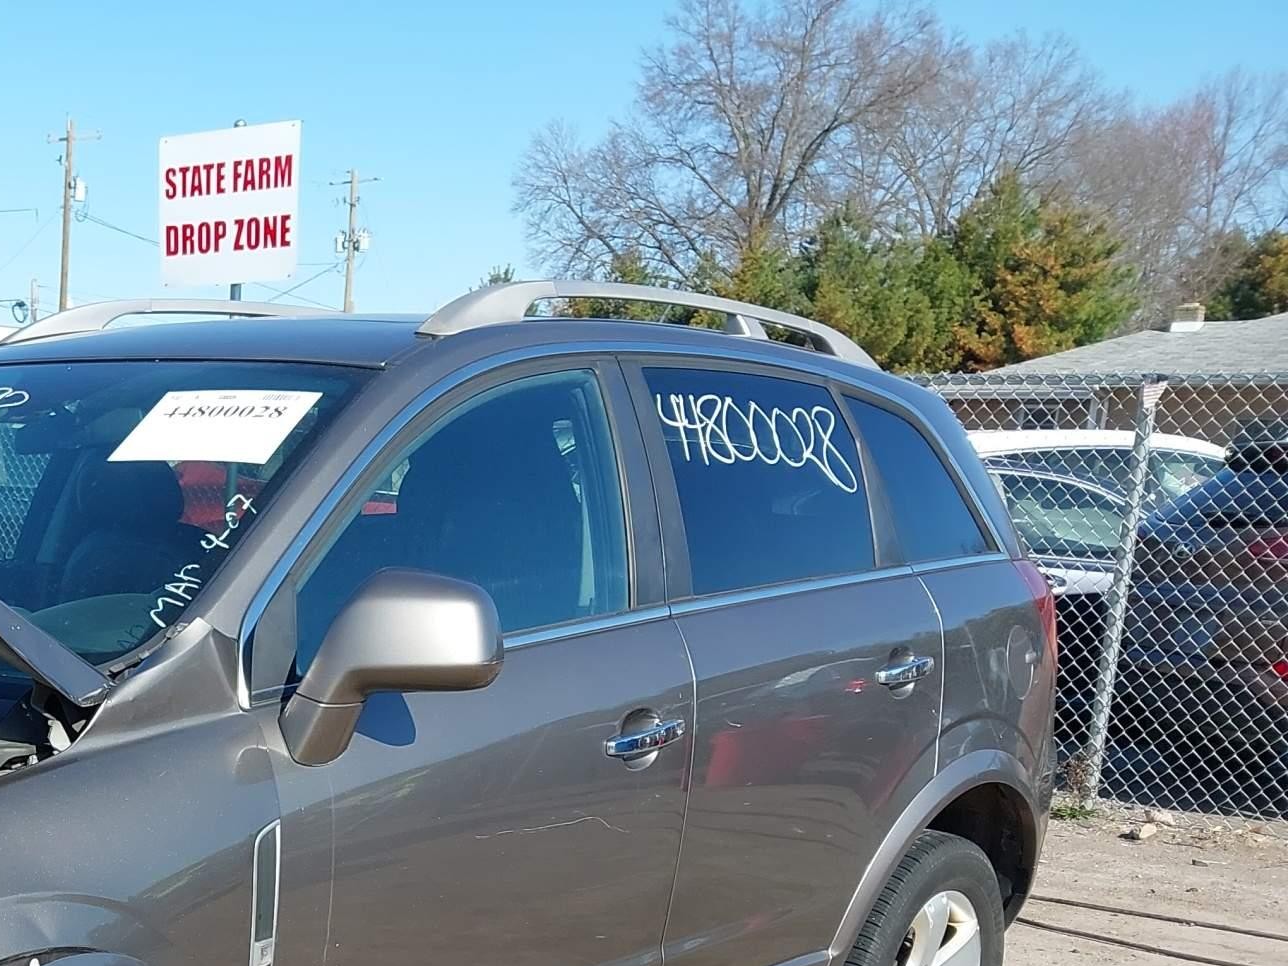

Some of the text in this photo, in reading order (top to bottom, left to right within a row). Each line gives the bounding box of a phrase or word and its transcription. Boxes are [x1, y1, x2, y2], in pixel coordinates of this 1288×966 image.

[164, 154, 294, 200] STATE FARM
[165, 214, 291, 257] DROP ZONE
[163, 405, 289, 419] 44800028
[656, 393, 858, 493] 44800028
